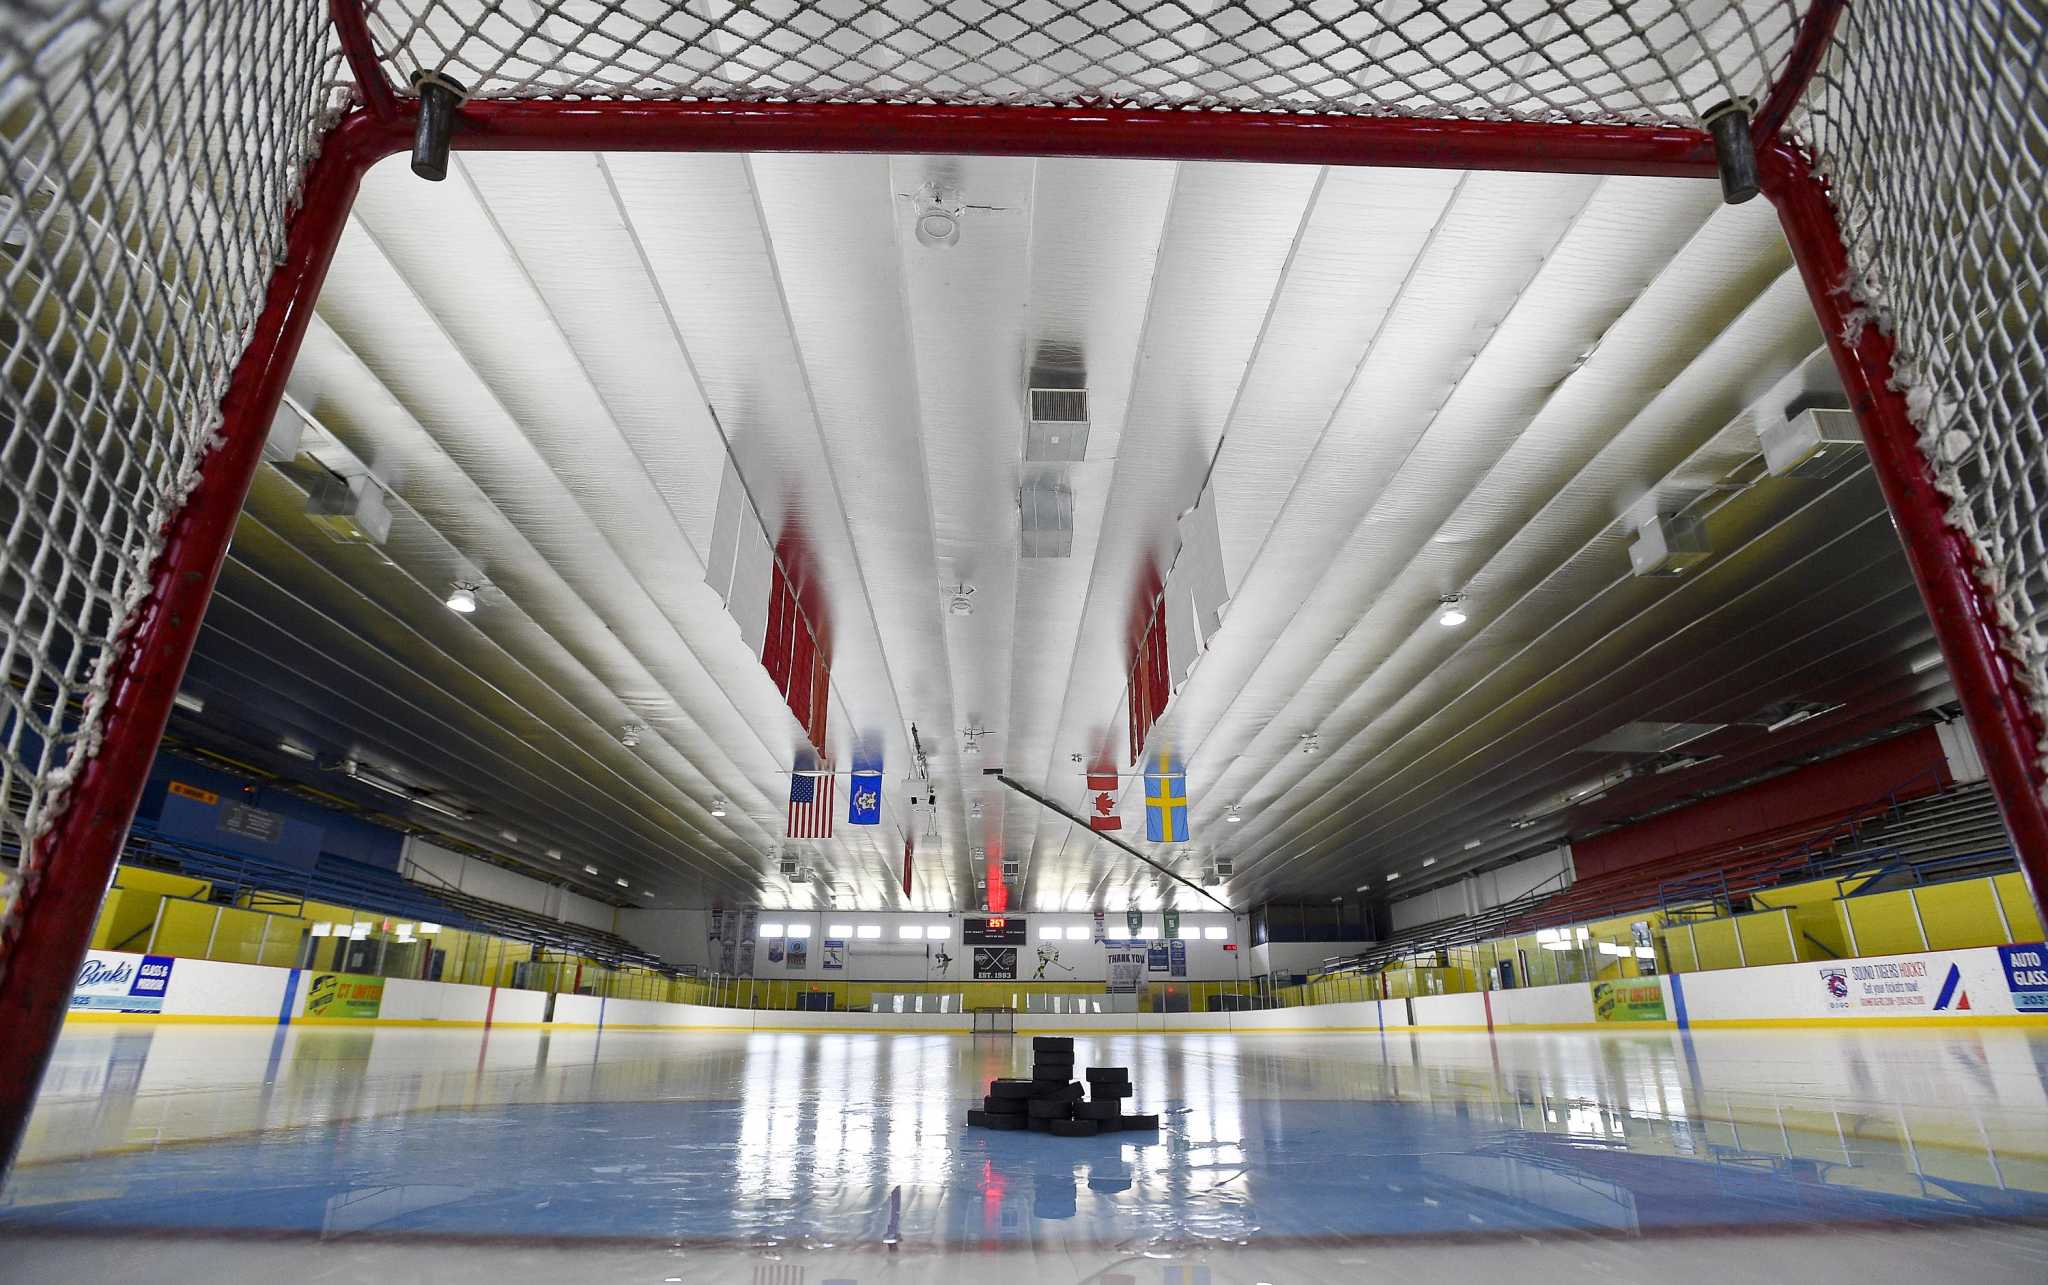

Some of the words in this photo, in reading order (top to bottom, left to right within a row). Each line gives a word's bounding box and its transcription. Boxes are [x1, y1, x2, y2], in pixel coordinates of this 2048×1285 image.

[1108, 953, 1131, 965] THANK
[1131, 953, 1145, 964] YOU
[2010, 952, 2041, 968] AUTO
[78, 960, 133, 987] Bink's
[1852, 965, 1875, 981] SOUND
[1874, 963, 1900, 979] TIGERS
[1899, 961, 1928, 978] HOCKEY
[2013, 970, 2048, 986] GLASS
